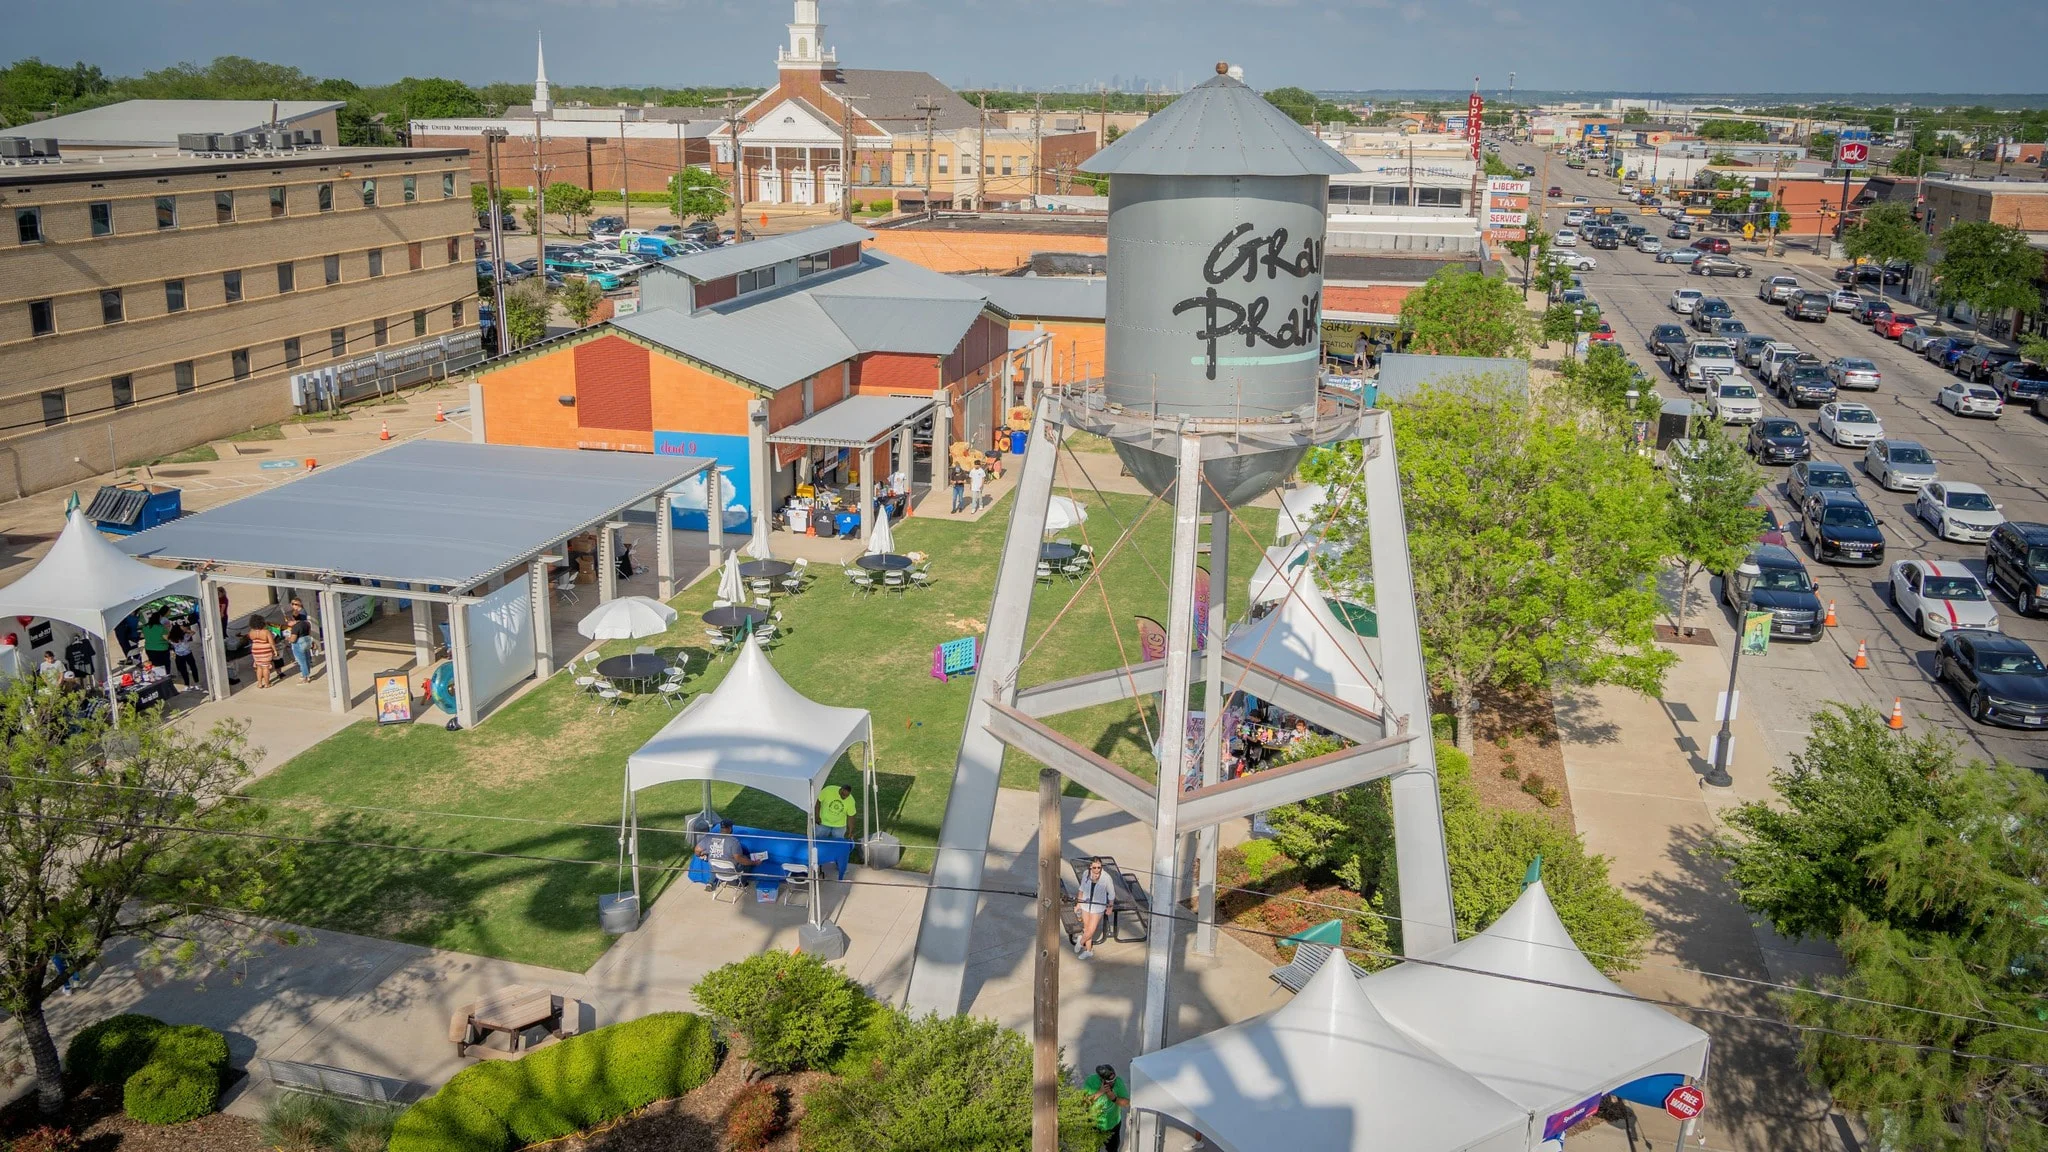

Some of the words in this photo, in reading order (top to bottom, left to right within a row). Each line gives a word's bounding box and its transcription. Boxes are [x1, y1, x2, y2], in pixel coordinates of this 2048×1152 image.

[1468, 98, 1479, 154] UPTOWN
[1840, 144, 1867, 161] Jack
[1492, 182, 1525, 191] LIBERTY
[1497, 198, 1517, 207] TAX
[1490, 214, 1522, 223] SERVICE
[688, 440, 697, 455] 9
[1679, 1091, 1700, 1106] FREE
